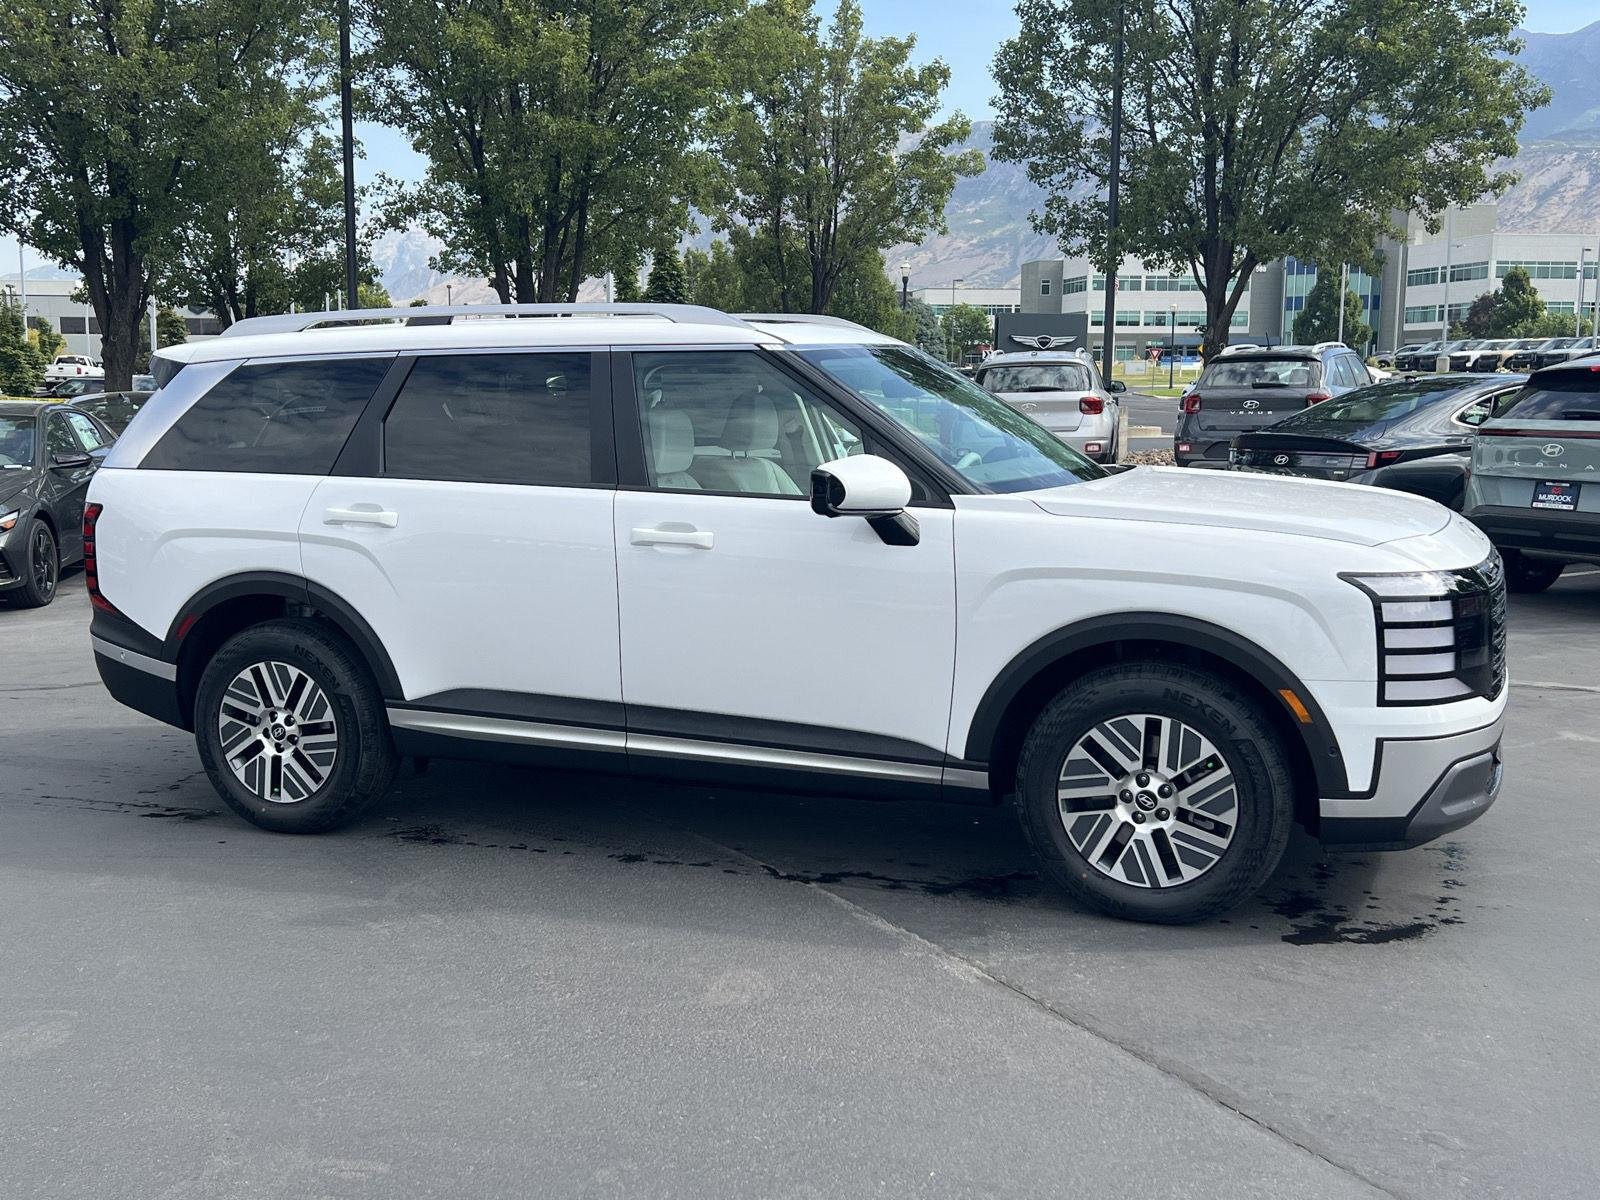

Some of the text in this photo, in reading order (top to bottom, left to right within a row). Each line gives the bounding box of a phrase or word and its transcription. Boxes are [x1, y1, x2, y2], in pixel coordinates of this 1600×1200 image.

[1514, 461, 1595, 471] KONA
[1538, 493, 1572, 502] MURDOCK
[294, 643, 341, 688] NEXEN
[1162, 687, 1238, 735] NEXEN
